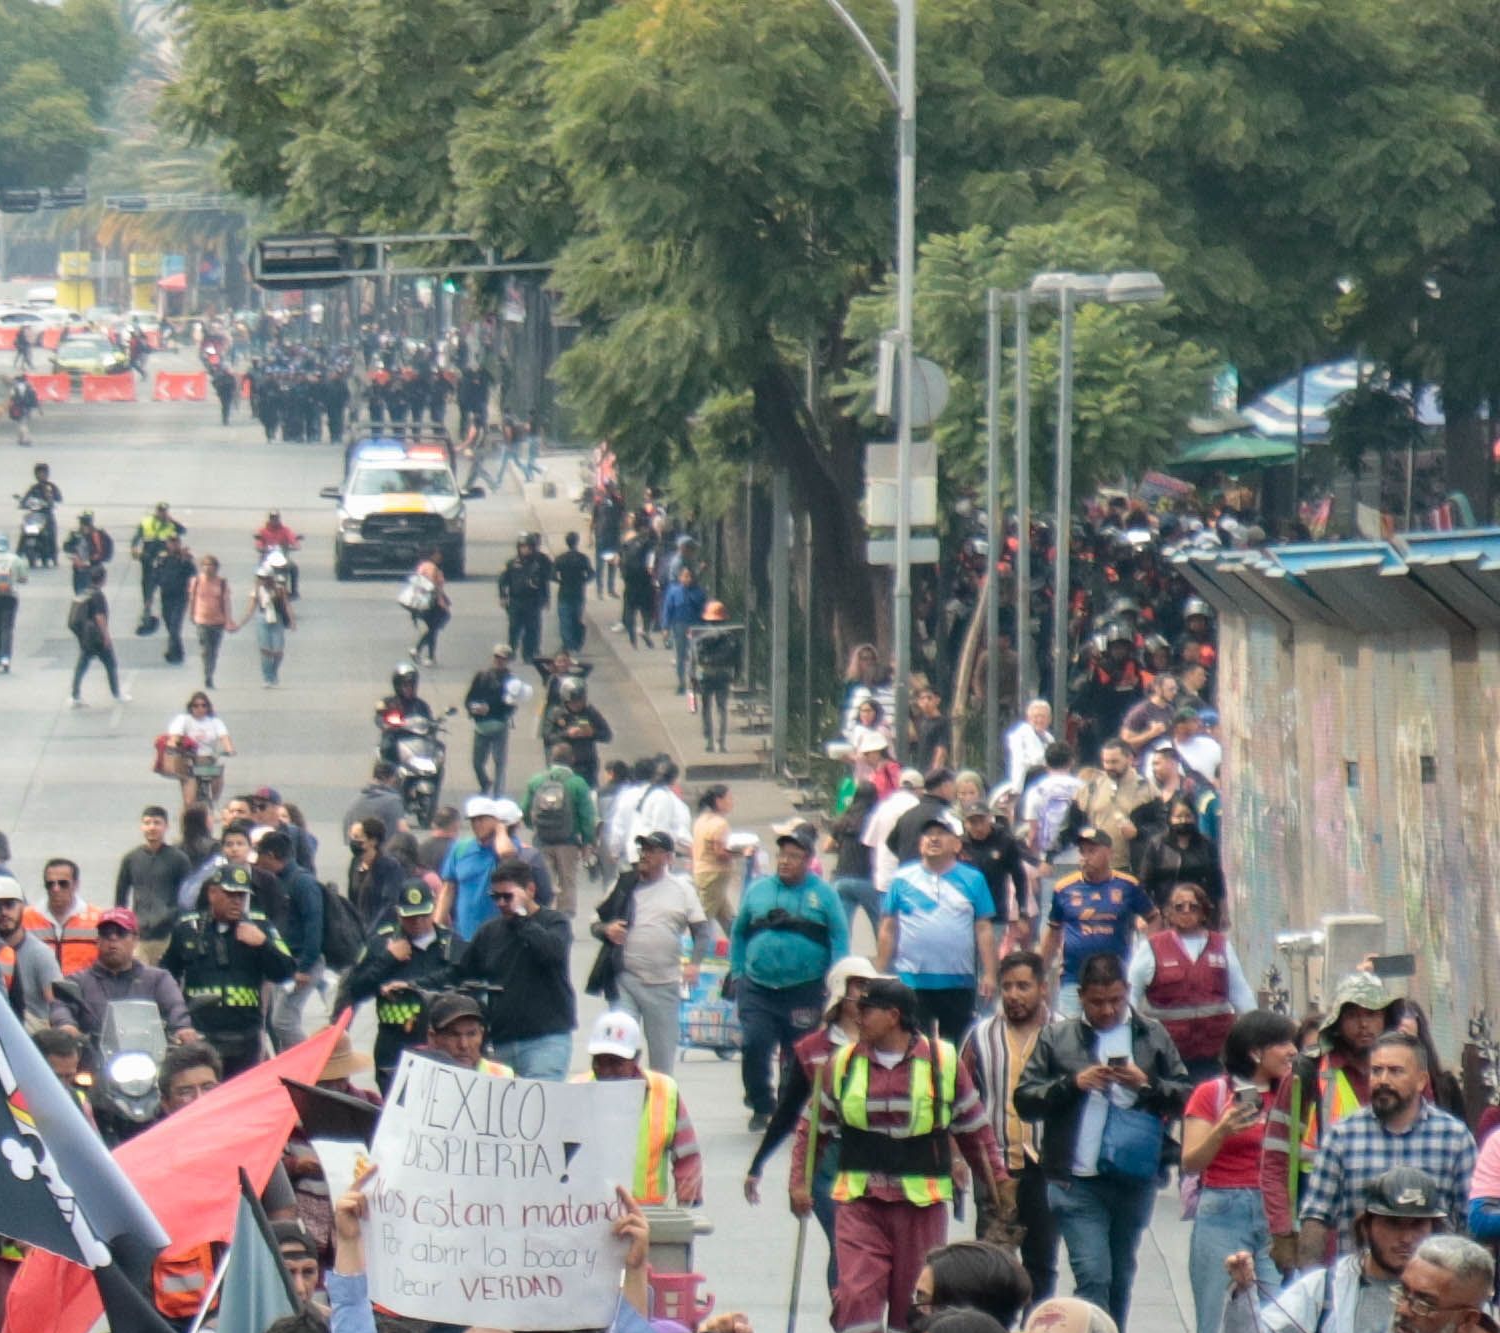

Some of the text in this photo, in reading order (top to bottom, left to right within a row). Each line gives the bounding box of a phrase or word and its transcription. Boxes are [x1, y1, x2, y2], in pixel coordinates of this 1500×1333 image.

[411, 1239, 581, 1268] abrir boca
[459, 1276, 564, 1303] VERDAD
